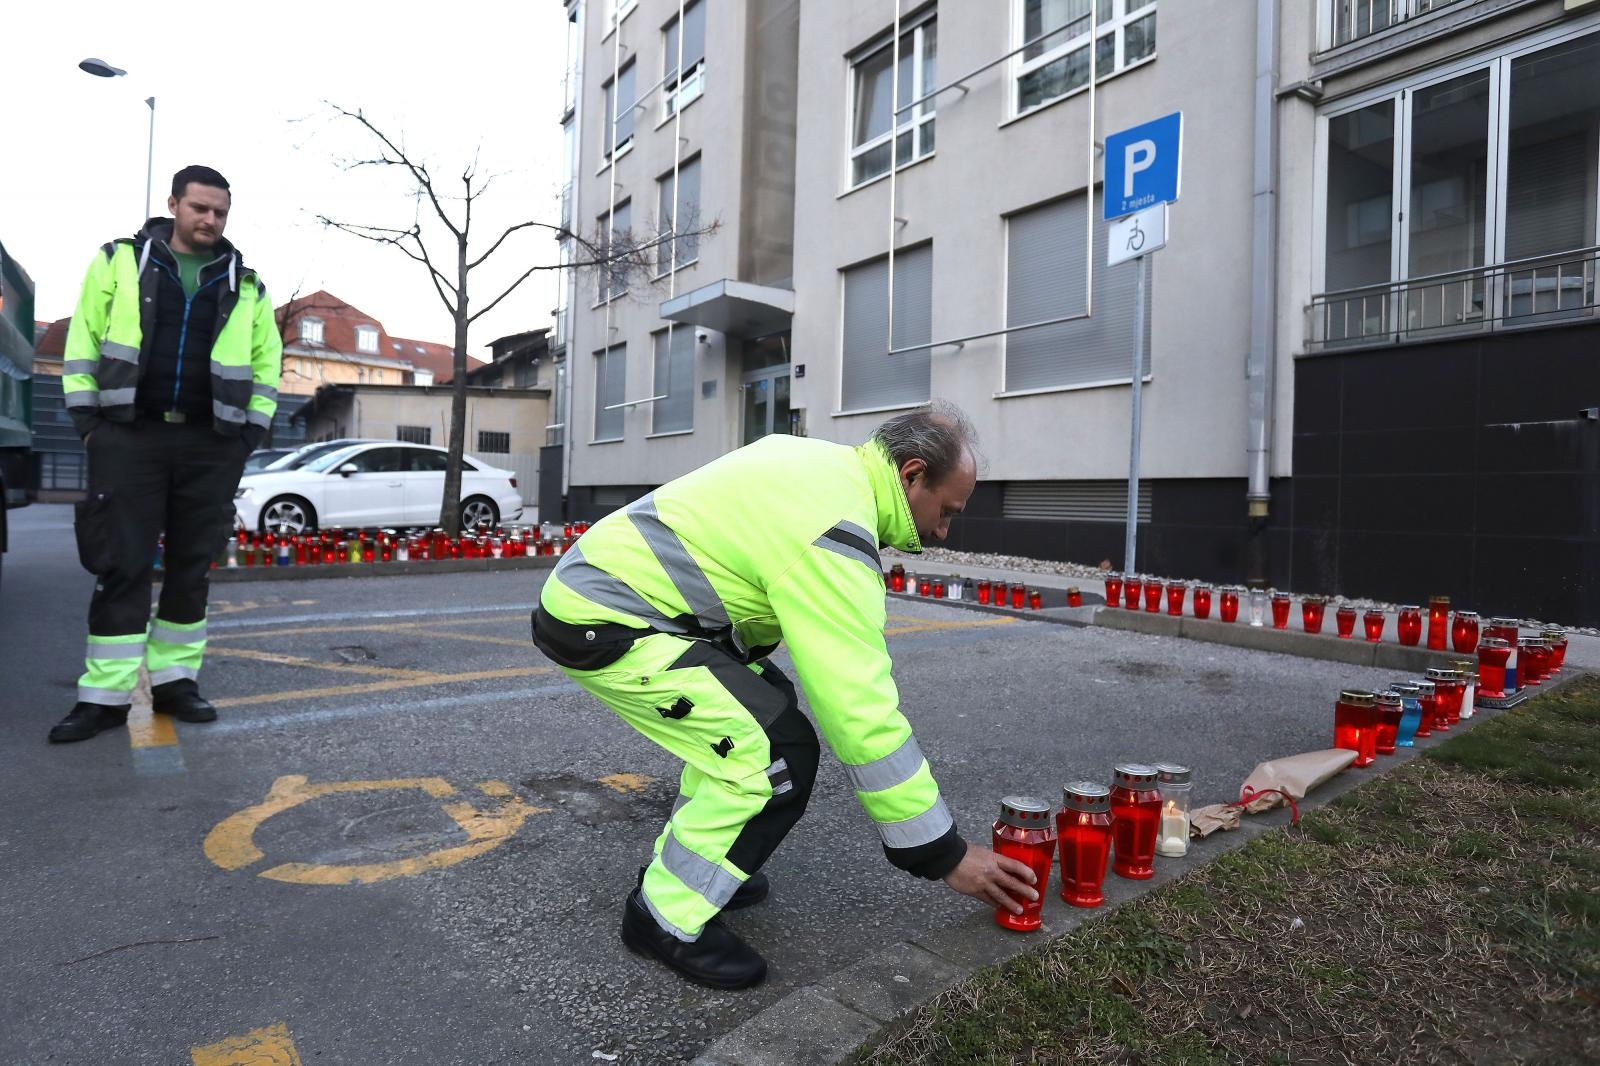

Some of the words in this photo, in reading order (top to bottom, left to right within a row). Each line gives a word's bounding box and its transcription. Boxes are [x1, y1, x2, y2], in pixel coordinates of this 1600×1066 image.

[1124, 139, 1156, 198] P
[1121, 200, 1127, 211] 2
[1129, 193, 1155, 208] mjesta
